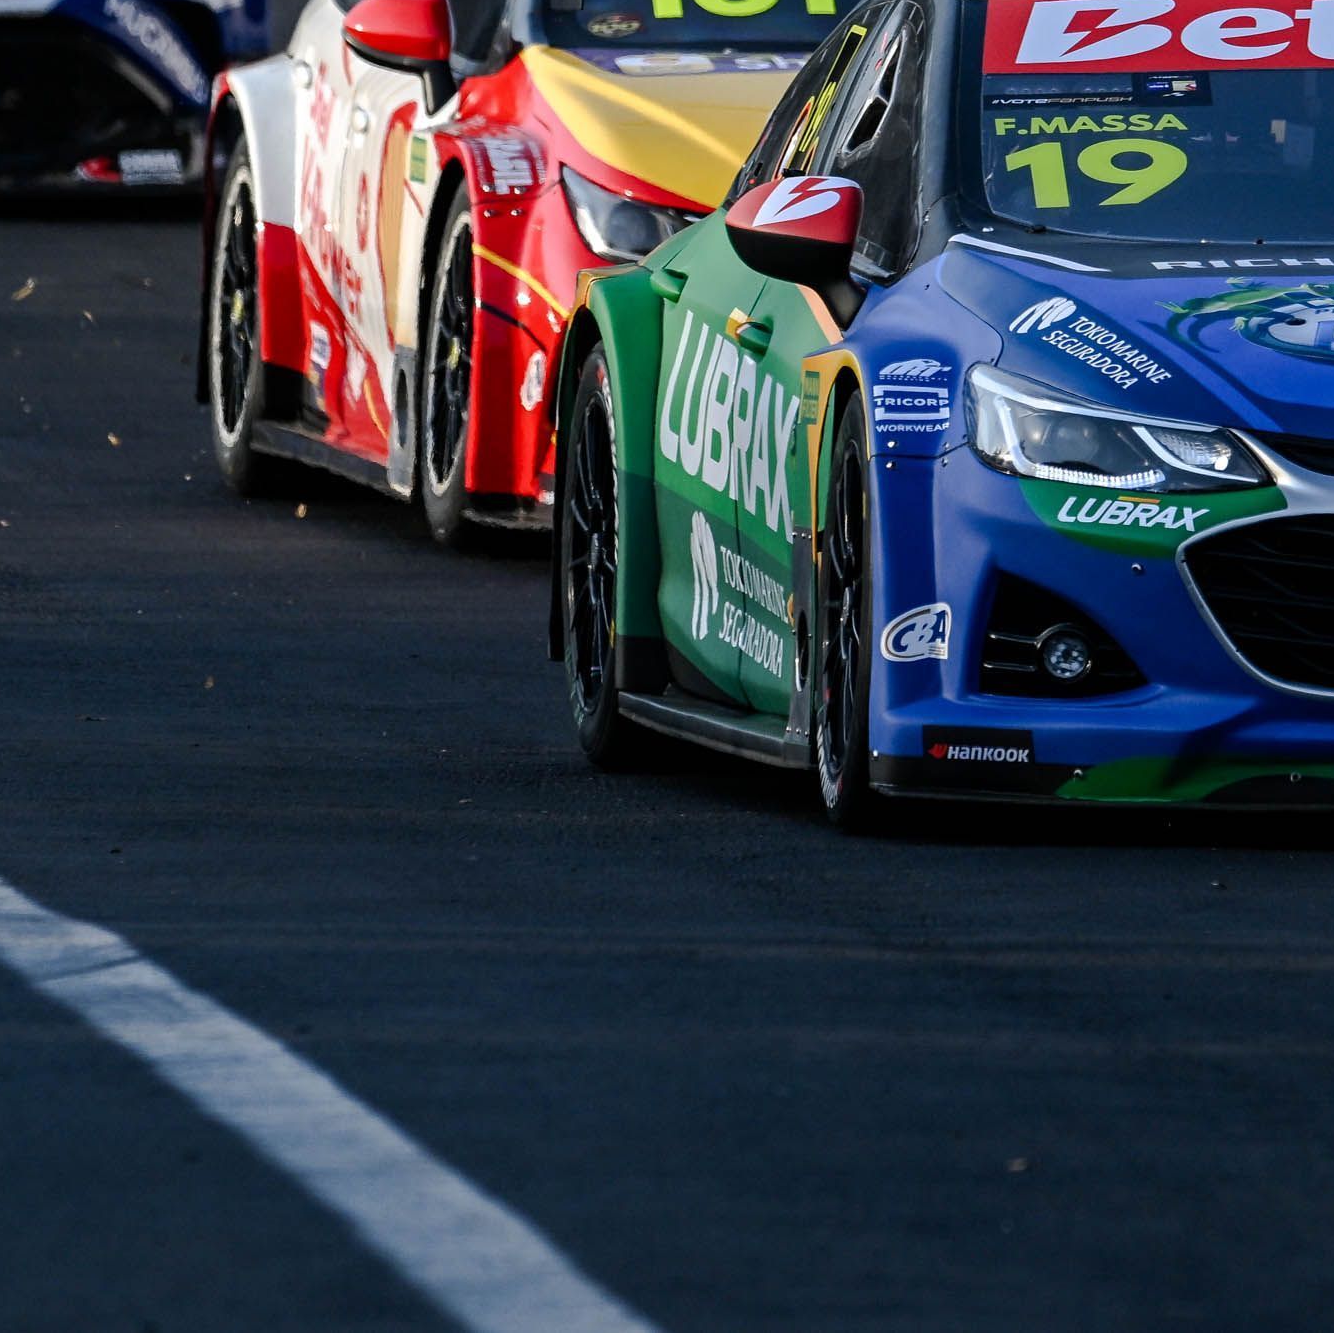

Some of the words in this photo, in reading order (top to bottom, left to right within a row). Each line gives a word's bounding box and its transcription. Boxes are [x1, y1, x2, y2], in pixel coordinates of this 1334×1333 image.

[994, 114, 1189, 136] F.MASSA
[1005, 138, 1188, 209] 19
[1041, 329, 1140, 390] SEGURADORA
[659, 309, 802, 544] LUBRAX
[873, 397, 949, 407] TRICORP
[1057, 495, 1212, 533] LUBRAX
[718, 601, 784, 679] SEGURADORA
[891, 609, 949, 655] CBA
